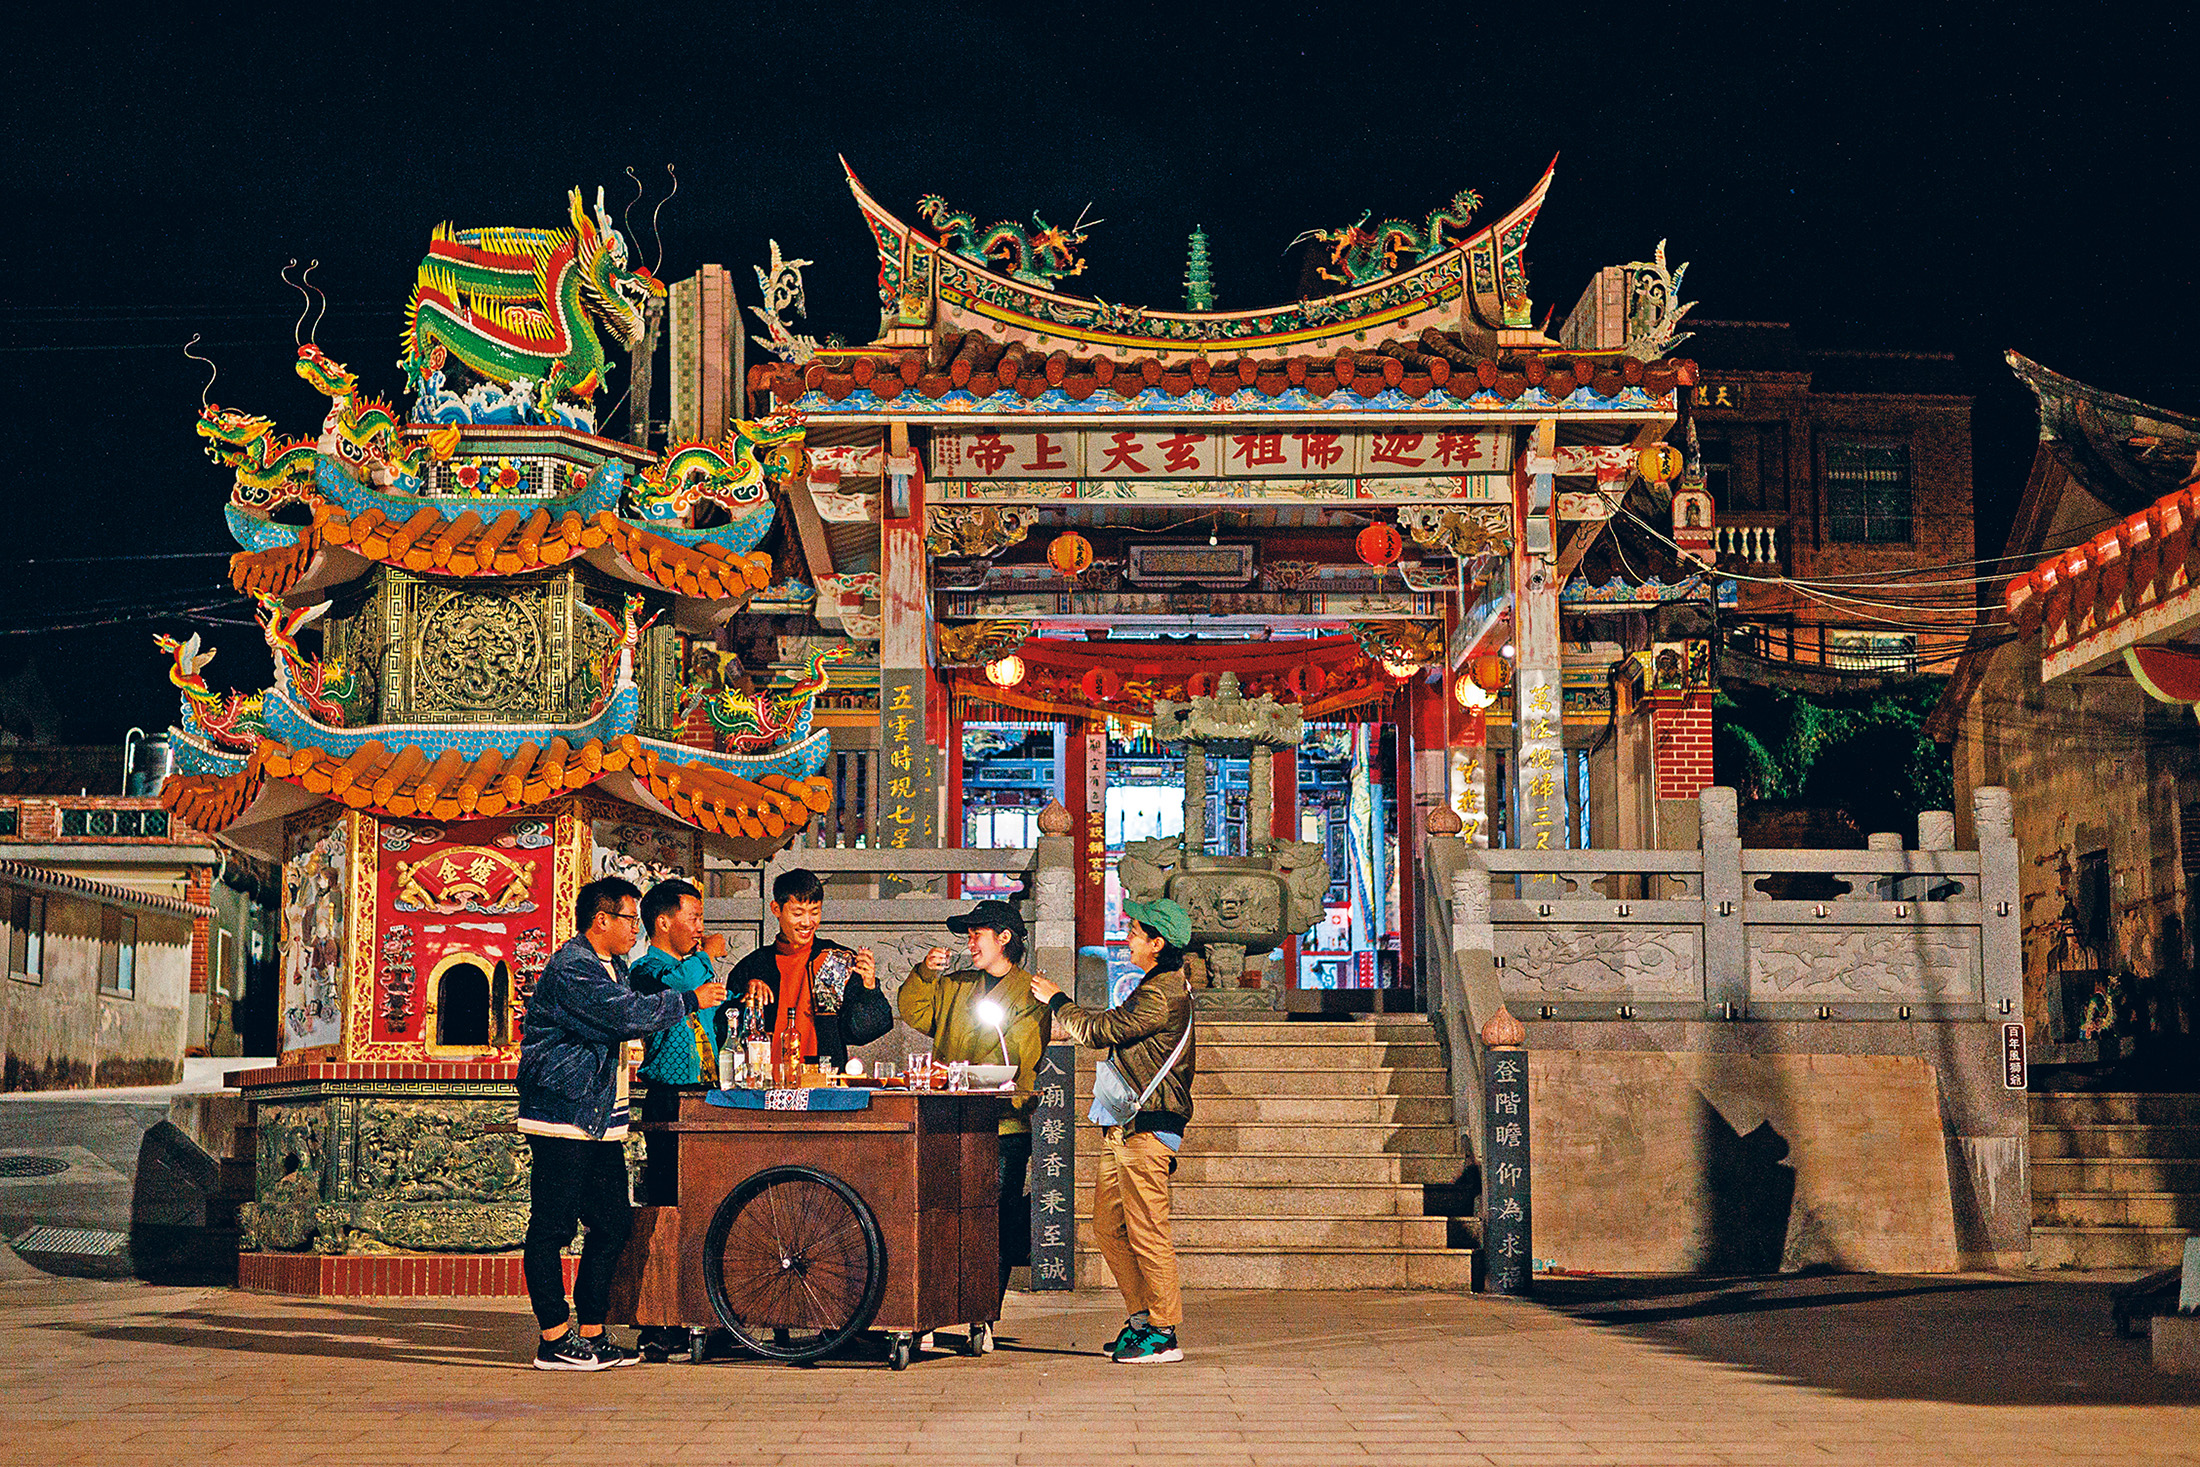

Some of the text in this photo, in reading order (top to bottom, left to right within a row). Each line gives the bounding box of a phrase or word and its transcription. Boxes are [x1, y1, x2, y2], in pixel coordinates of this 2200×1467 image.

[966, 429, 1483, 475] 釋迦佛祖玄天上帝
[887, 684, 915, 883] 五雲時現七星
[1088, 738, 1103, 812] 觀空有色
[1529, 684, 1557, 883] 萬法總歸三尺
[436, 856, 497, 886] 金爐
[2008, 1026, 2022, 1086] 百年風獅爺
[1038, 1057, 1068, 1282] 入廟馨香秉至誠
[1494, 1059, 1524, 1289] 登階瞻仰為求福
